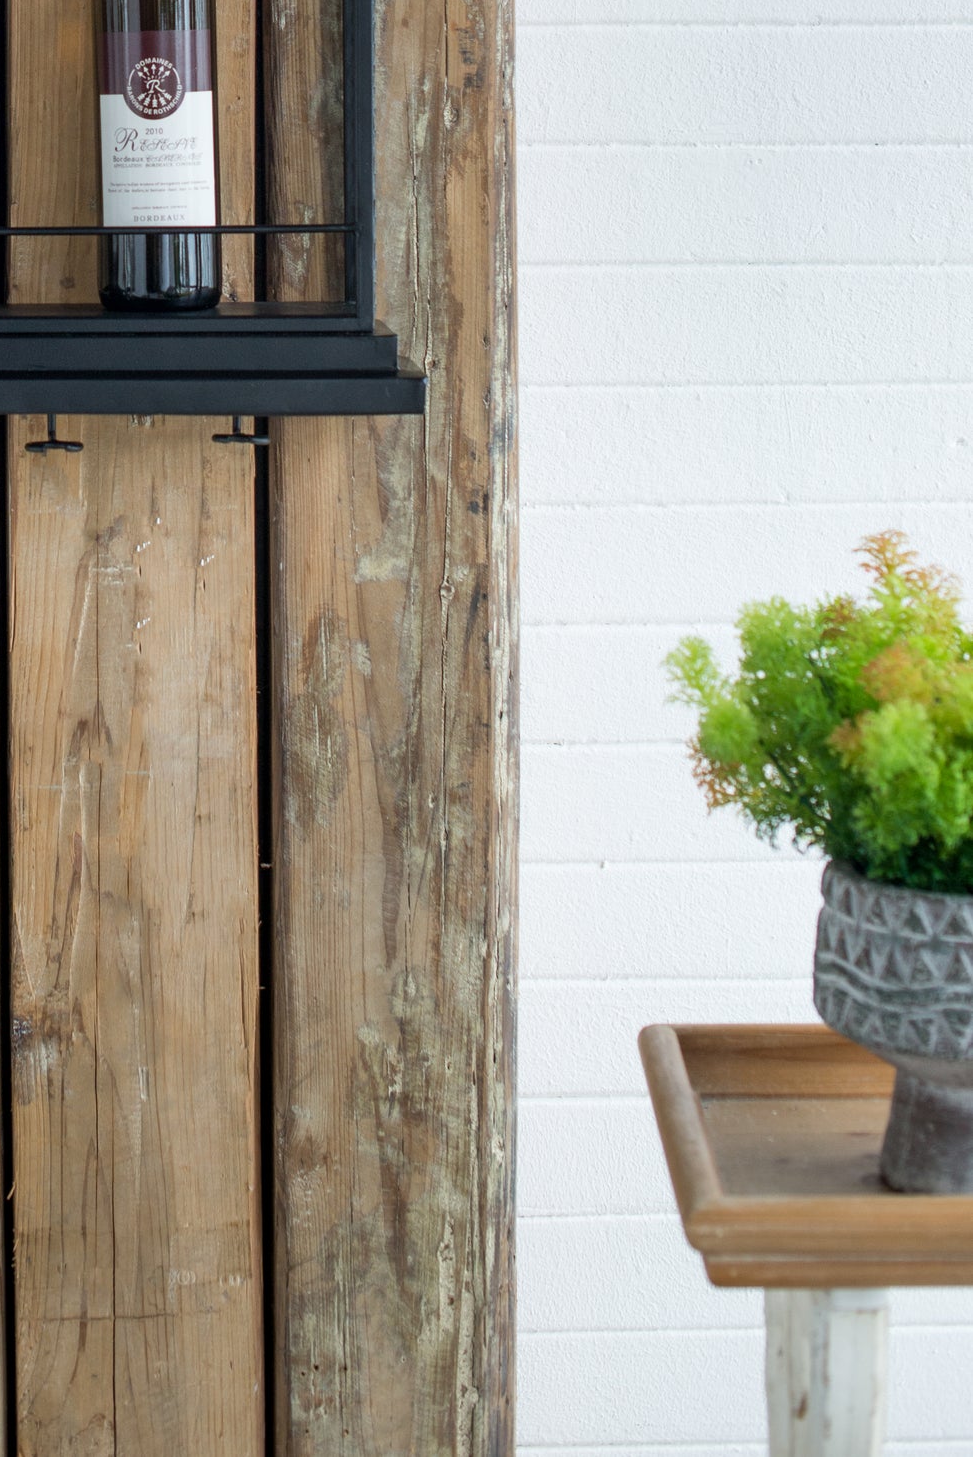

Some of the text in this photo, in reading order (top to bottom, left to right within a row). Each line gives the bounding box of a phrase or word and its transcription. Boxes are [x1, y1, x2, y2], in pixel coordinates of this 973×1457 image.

[135, 57, 173, 69] DOMAINES
[153, 84, 183, 115] ROTHSCHILD
[145, 127, 164, 135] 2010
[113, 155, 144, 163] Bordeaux
[133, 213, 186, 223] BORDEAUX
